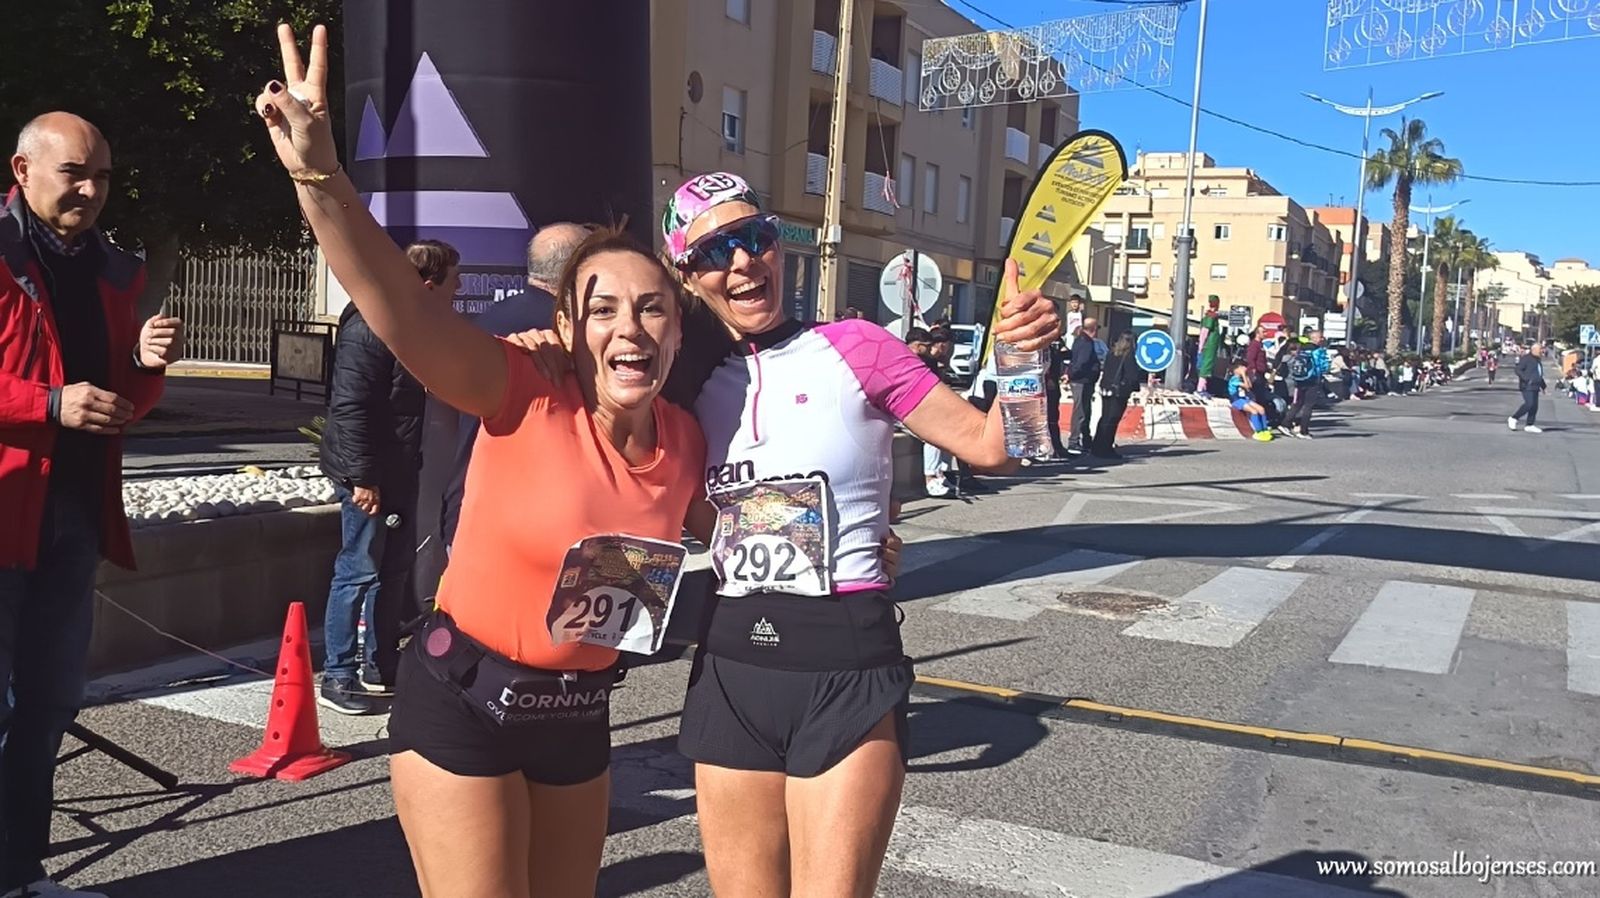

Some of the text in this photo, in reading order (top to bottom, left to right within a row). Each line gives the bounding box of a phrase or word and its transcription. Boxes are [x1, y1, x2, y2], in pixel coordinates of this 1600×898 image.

[733, 543, 796, 582] 292
[563, 594, 637, 632] 291
[500, 687, 608, 709] DORNNA
